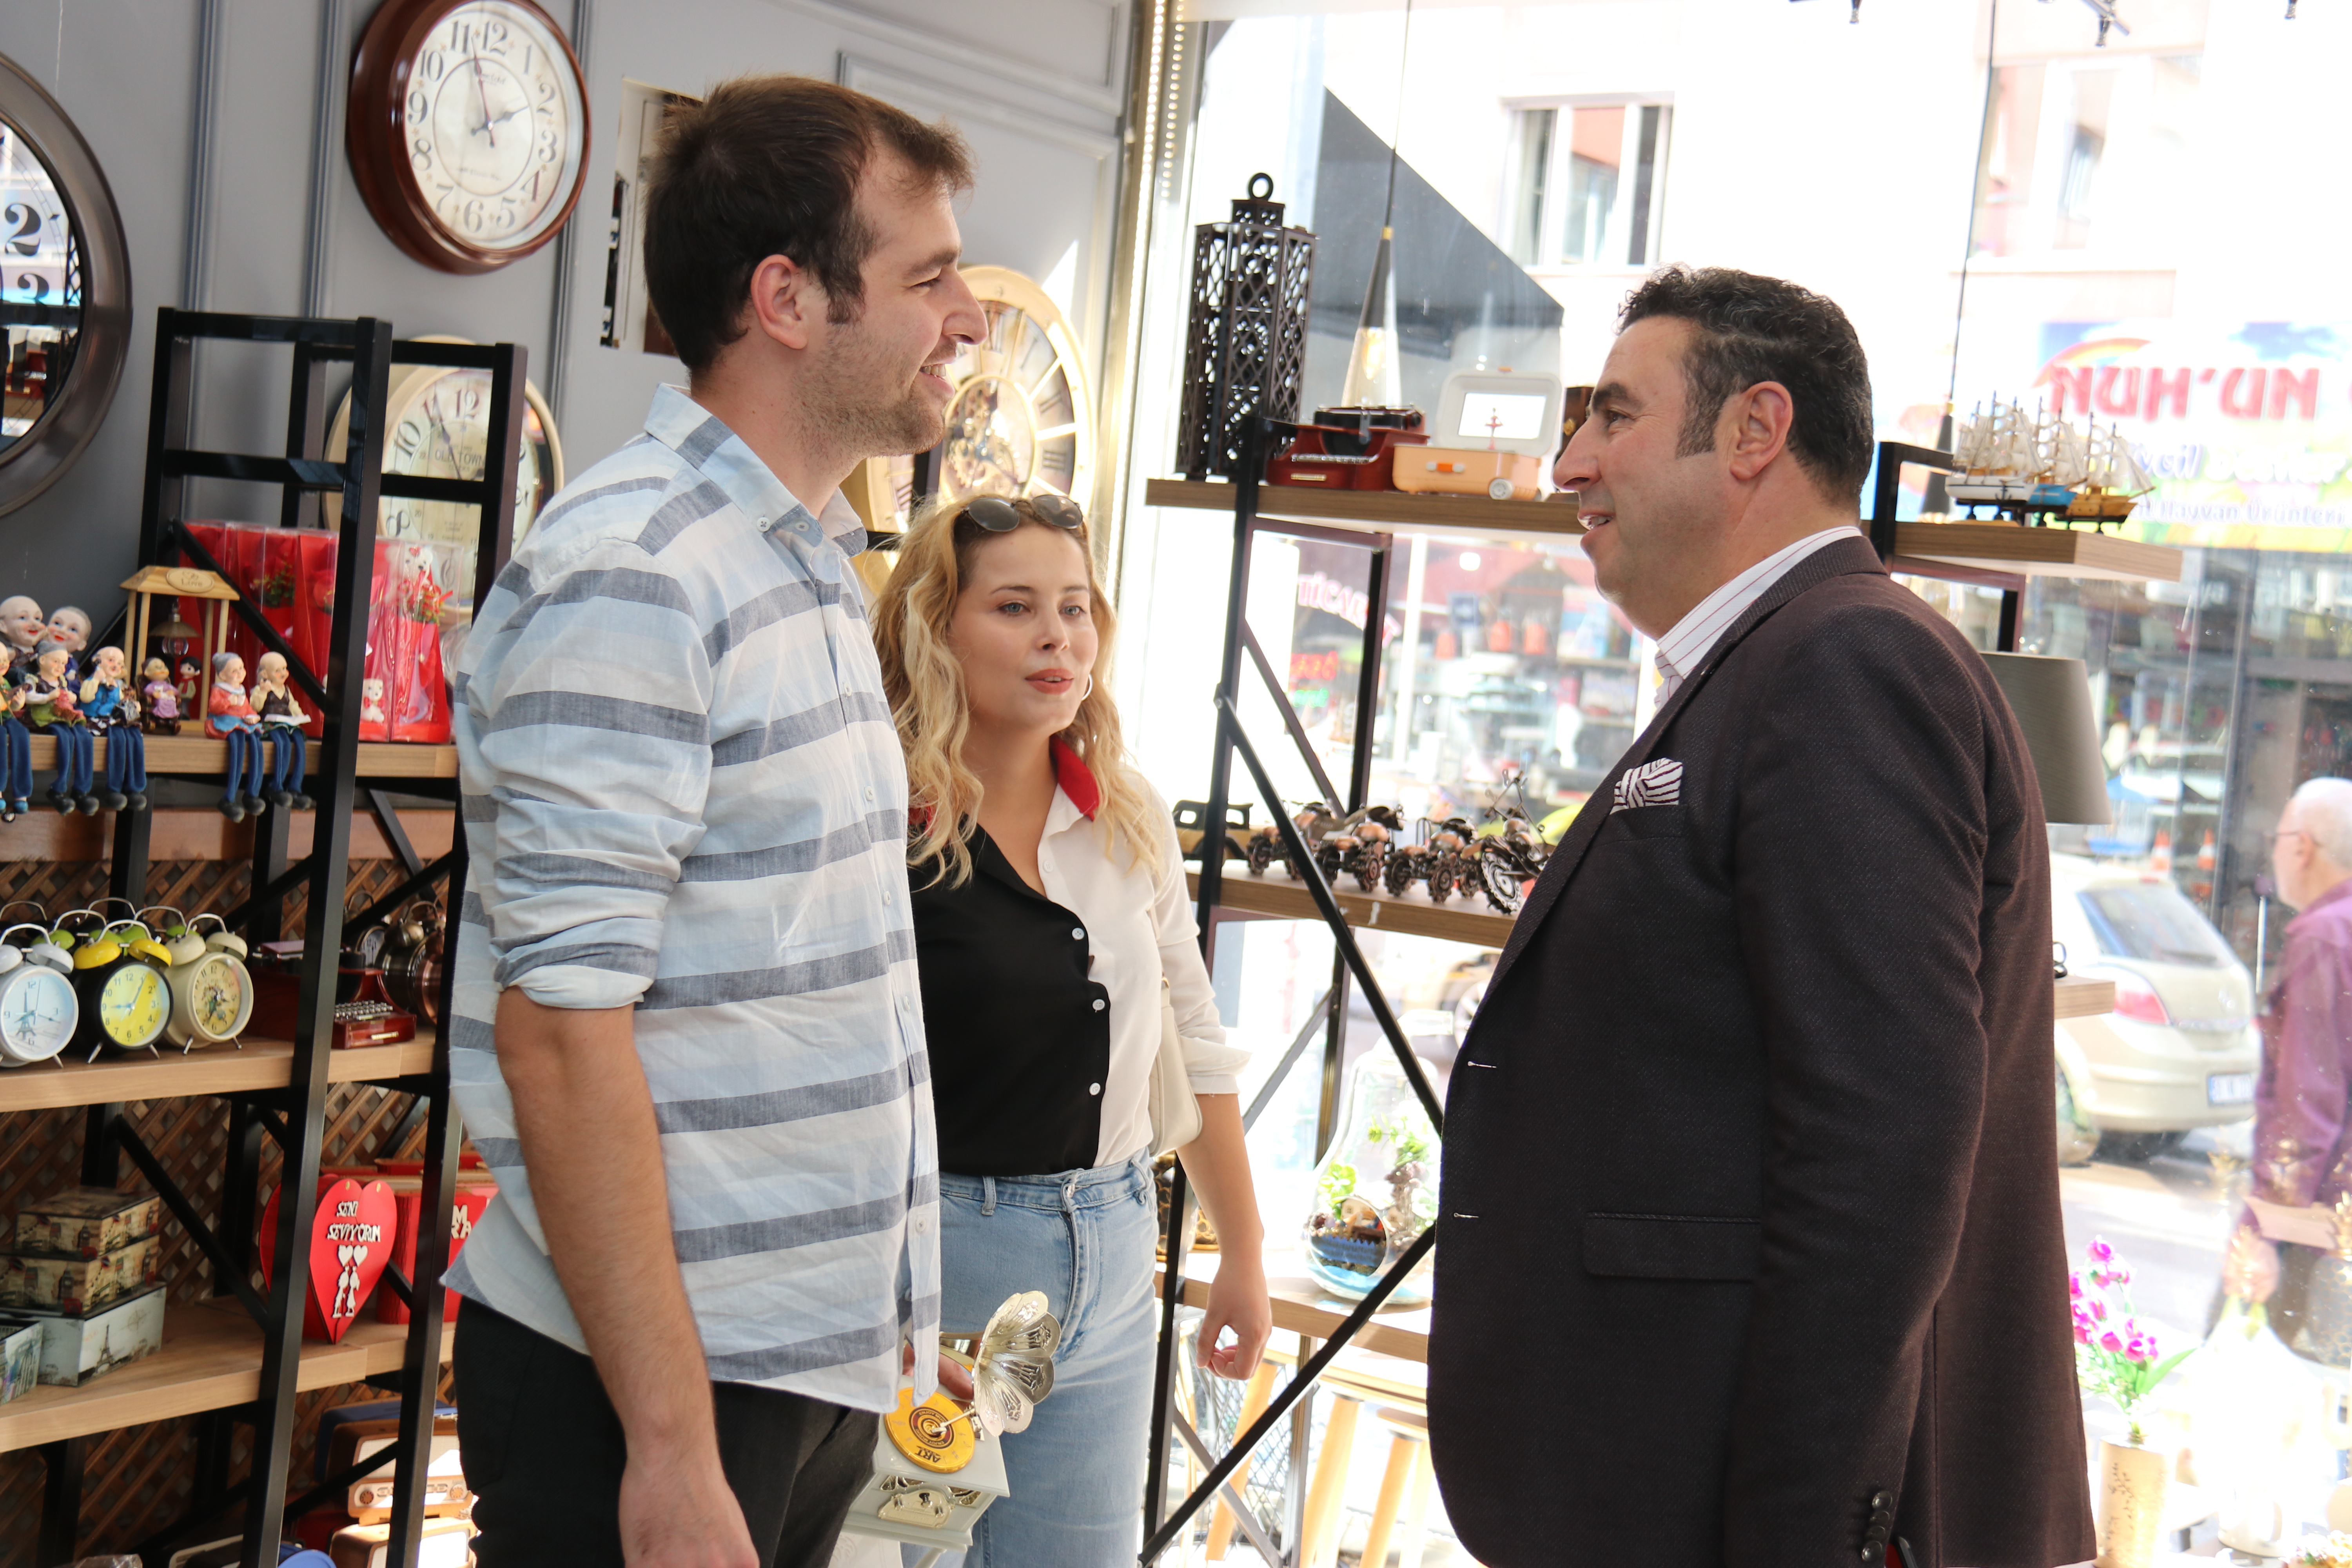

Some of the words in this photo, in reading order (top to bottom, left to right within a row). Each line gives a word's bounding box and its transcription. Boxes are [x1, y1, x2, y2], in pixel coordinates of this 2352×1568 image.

[450, 20, 470, 54] 11
[481, 21, 507, 57] 12
[419, 49, 443, 82] 10
[523, 44, 532, 76] 1
[407, 91, 428, 125] 9
[536, 83, 555, 116] 2
[412, 139, 432, 171] 8
[538, 131, 557, 163] 3
[436, 183, 454, 214] 7
[520, 170, 539, 202] 4
[463, 200, 483, 233] 6
[496, 197, 516, 229] 5
[5, 203, 41, 257] 2
[456, 388, 479, 419] 12
[393, 421, 421, 462] 10
[456, 452, 483, 465] TOWN
[1043, 450, 1066, 470] III
[140, 1025, 144, 1034] 5
[914, 1448, 941, 1463] ART
